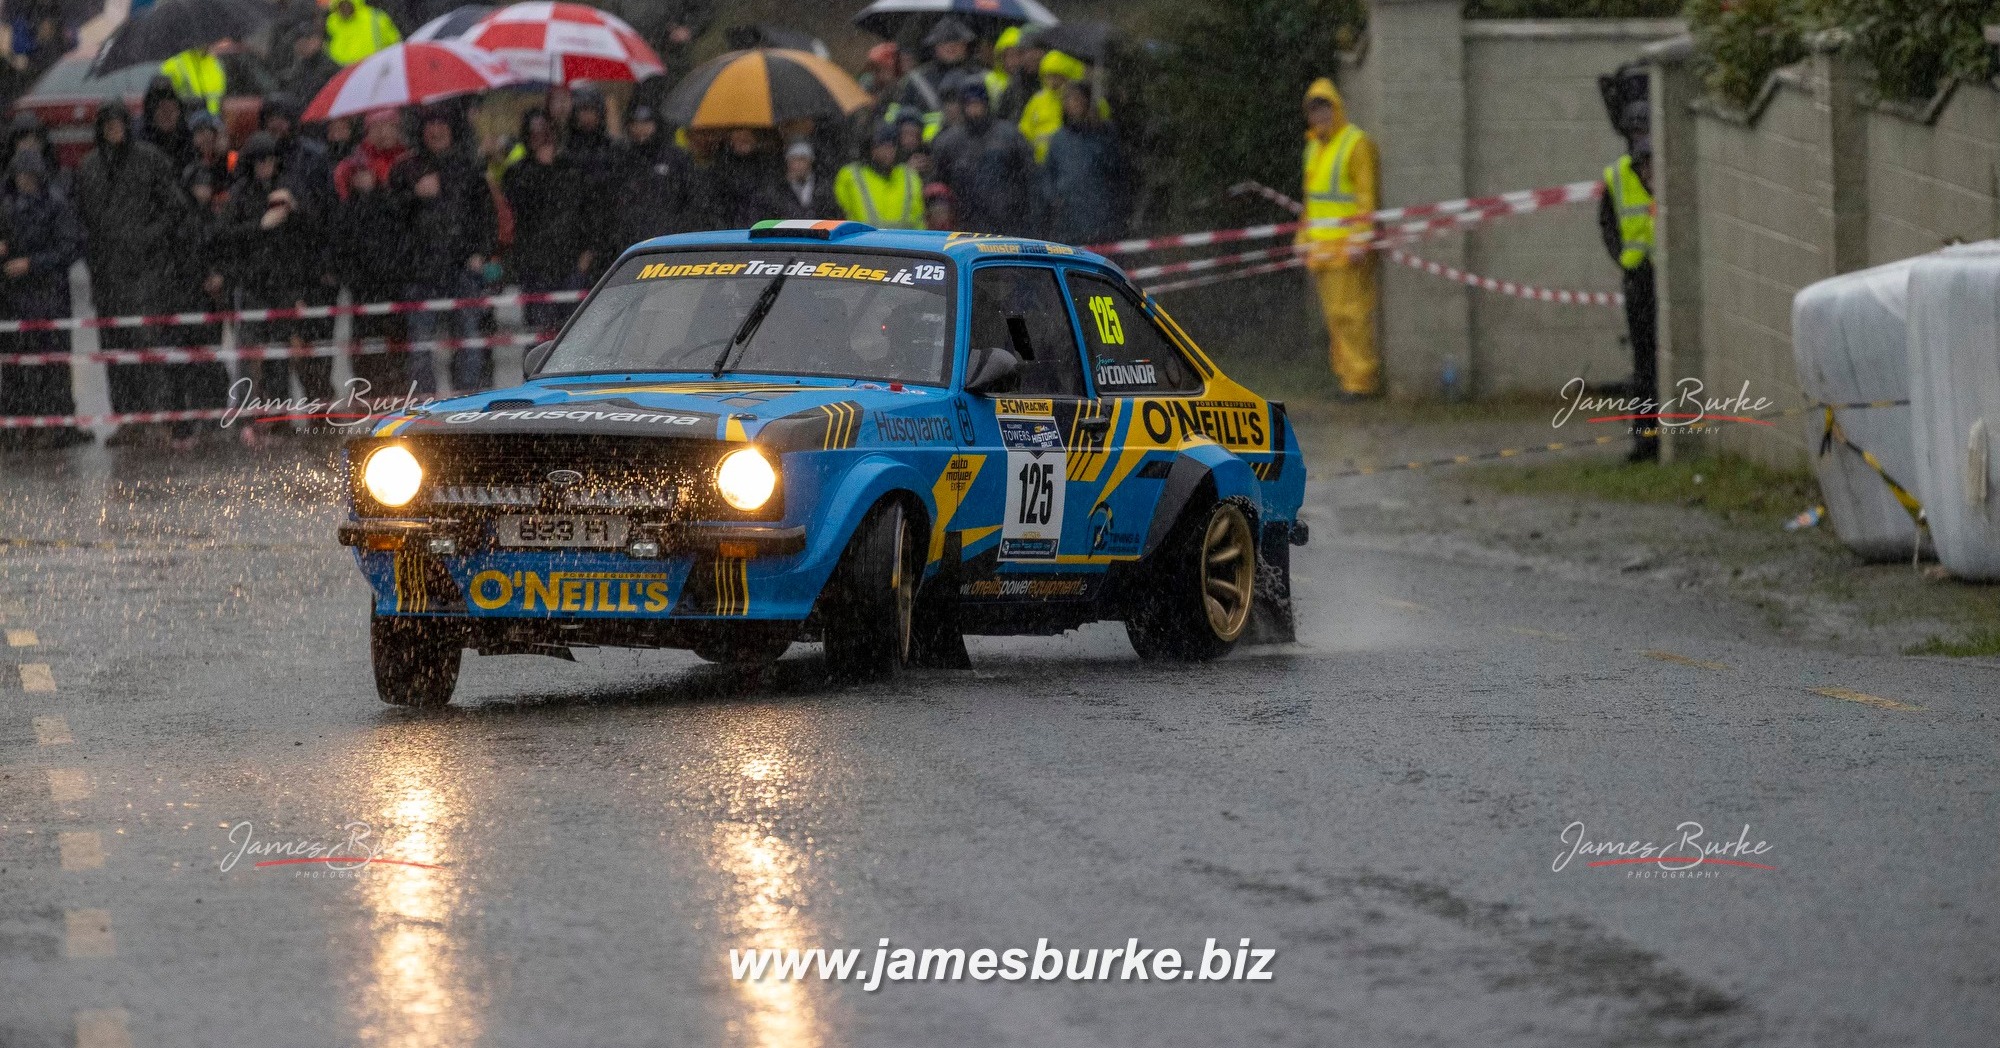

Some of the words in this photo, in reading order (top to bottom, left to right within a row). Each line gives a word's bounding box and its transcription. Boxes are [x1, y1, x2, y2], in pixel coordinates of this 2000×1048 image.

[636, 260, 914, 286] MunsterTradeSales.ie
[914, 264, 946, 281] 125
[1088, 295, 1125, 346] 125
[489, 409, 702, 426] Husqvarna
[873, 410, 953, 446] Husqvarna
[1142, 400, 1264, 446] O'NEILL'S
[1003, 430, 1031, 442] TOWERS
[951, 458, 969, 470] auto
[1018, 462, 1055, 526] 125
[470, 570, 669, 613] O'NEILL'S
